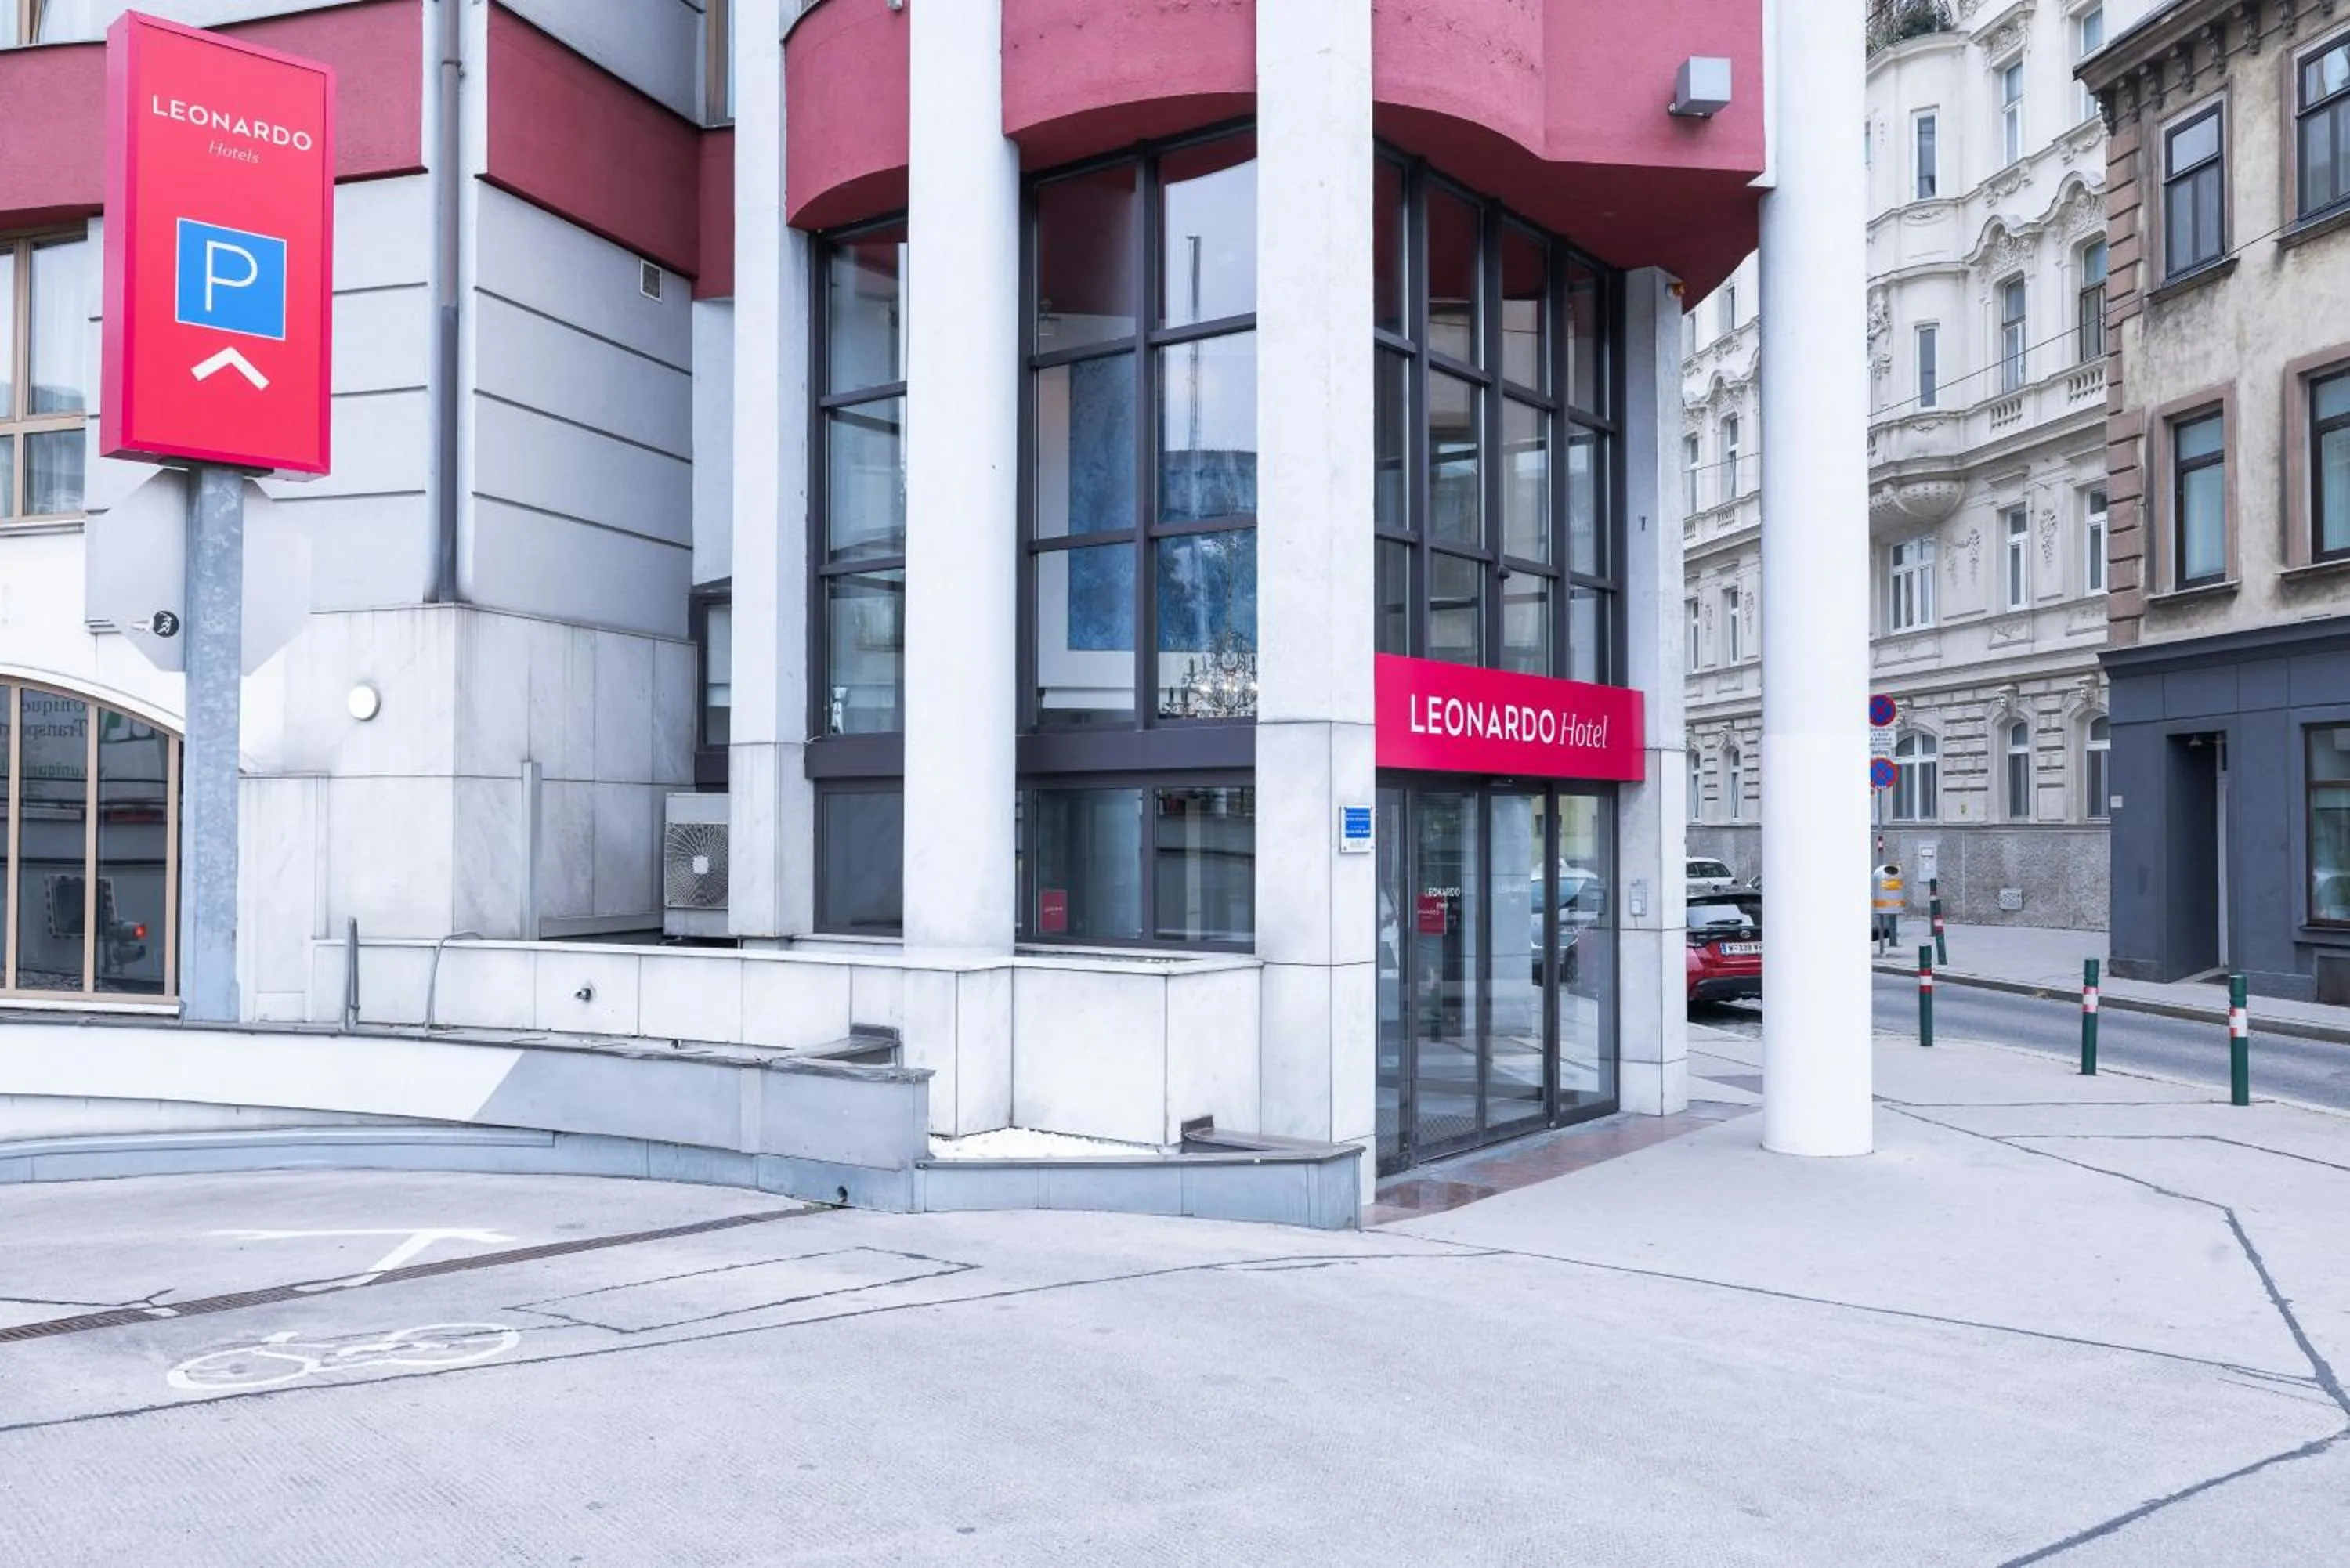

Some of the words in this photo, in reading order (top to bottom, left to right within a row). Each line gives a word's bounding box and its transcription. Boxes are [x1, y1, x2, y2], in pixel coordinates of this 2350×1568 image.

[152, 94, 313, 151] LEONARDO
[208, 139, 261, 164] Hotels
[205, 240, 258, 313] P
[1410, 693, 1556, 744] LEONARDO
[1558, 712, 1608, 749] Hotel
